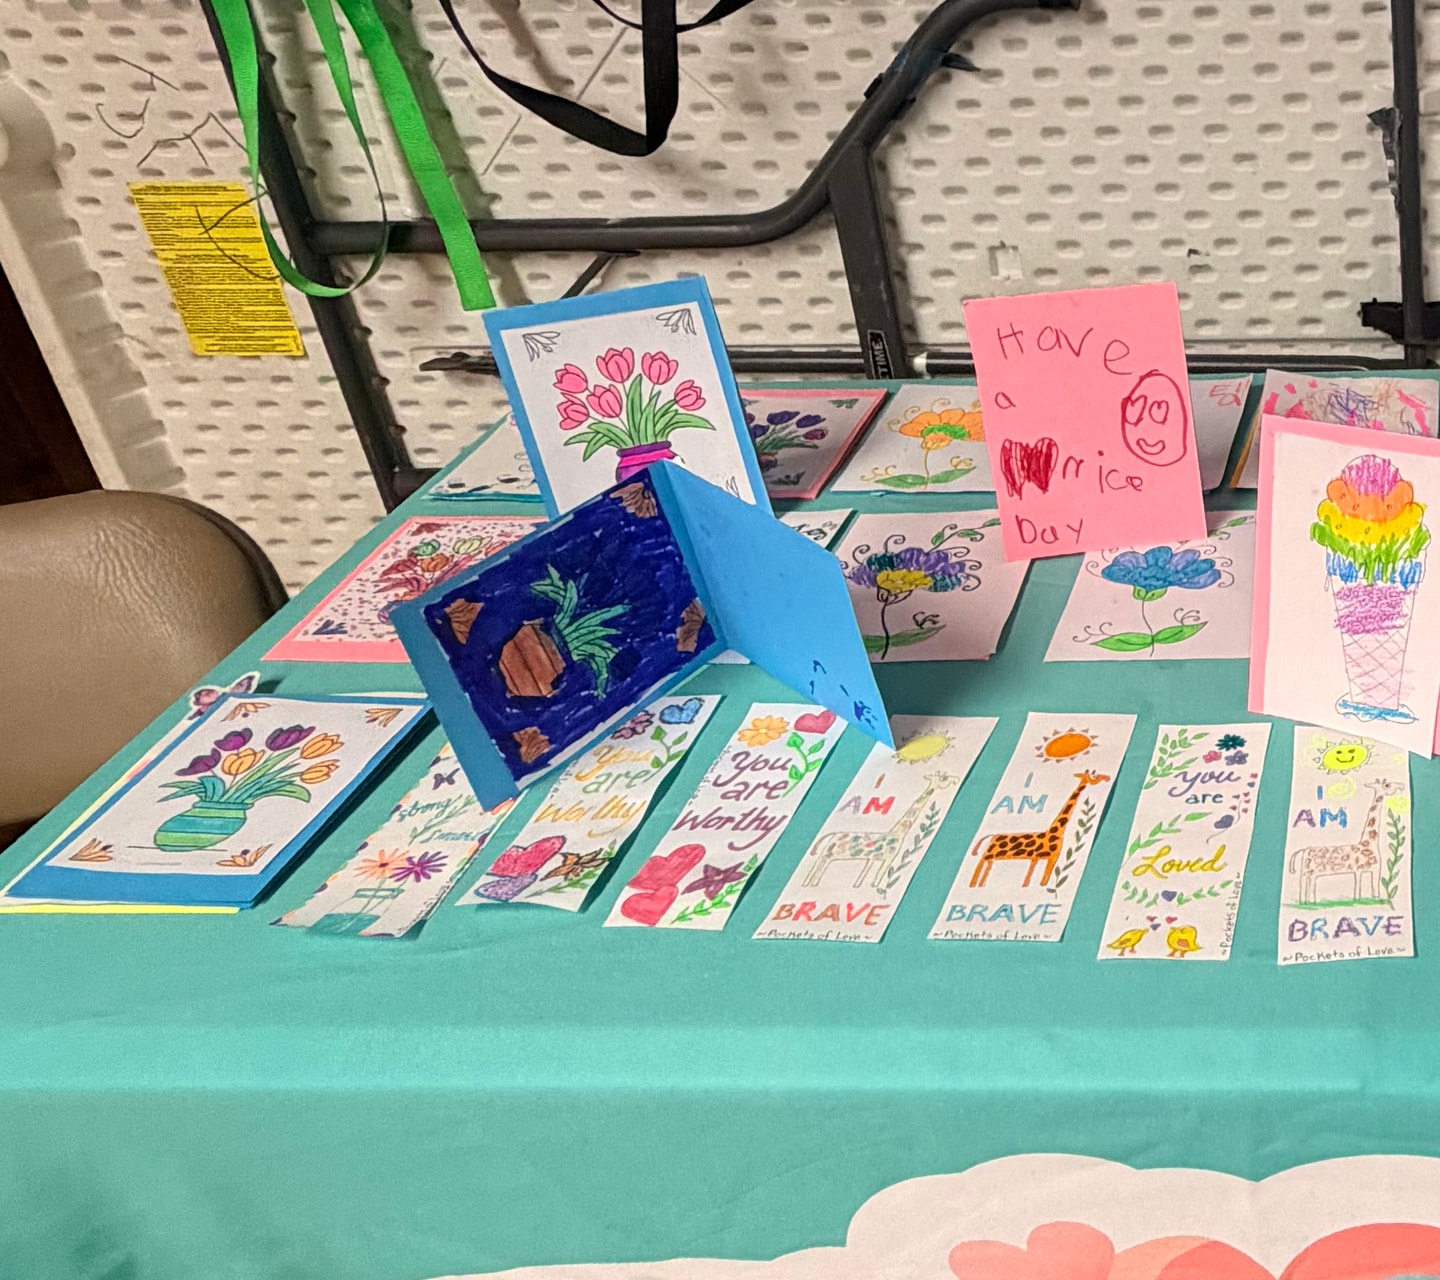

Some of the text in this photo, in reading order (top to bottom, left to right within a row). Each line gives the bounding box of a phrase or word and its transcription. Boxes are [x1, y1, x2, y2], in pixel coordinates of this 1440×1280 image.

[871, 339, 889, 378] TIME
[997, 322, 1133, 375] Have
[994, 391, 1017, 410] a
[1063, 450, 1144, 494] nice
[1015, 515, 1084, 545] Day
[575, 745, 654, 782] You
[712, 751, 792, 788] You
[582, 769, 651, 794] are
[720, 780, 789, 801] are
[874, 773, 886, 789] I
[1024, 771, 1034, 788] I
[1168, 770, 1241, 797] you
[837, 795, 896, 815] AM
[991, 794, 1048, 814] AM
[1185, 792, 1224, 804] are
[1317, 785, 1324, 800] I
[534, 795, 647, 839] Worthy
[672, 806, 788, 851] Worthy
[1293, 807, 1348, 828] AM
[1132, 844, 1227, 880] Loved
[772, 901, 891, 926] BRAVE
[946, 903, 1062, 924] BRAVE
[1288, 915, 1404, 942] BRAVE
